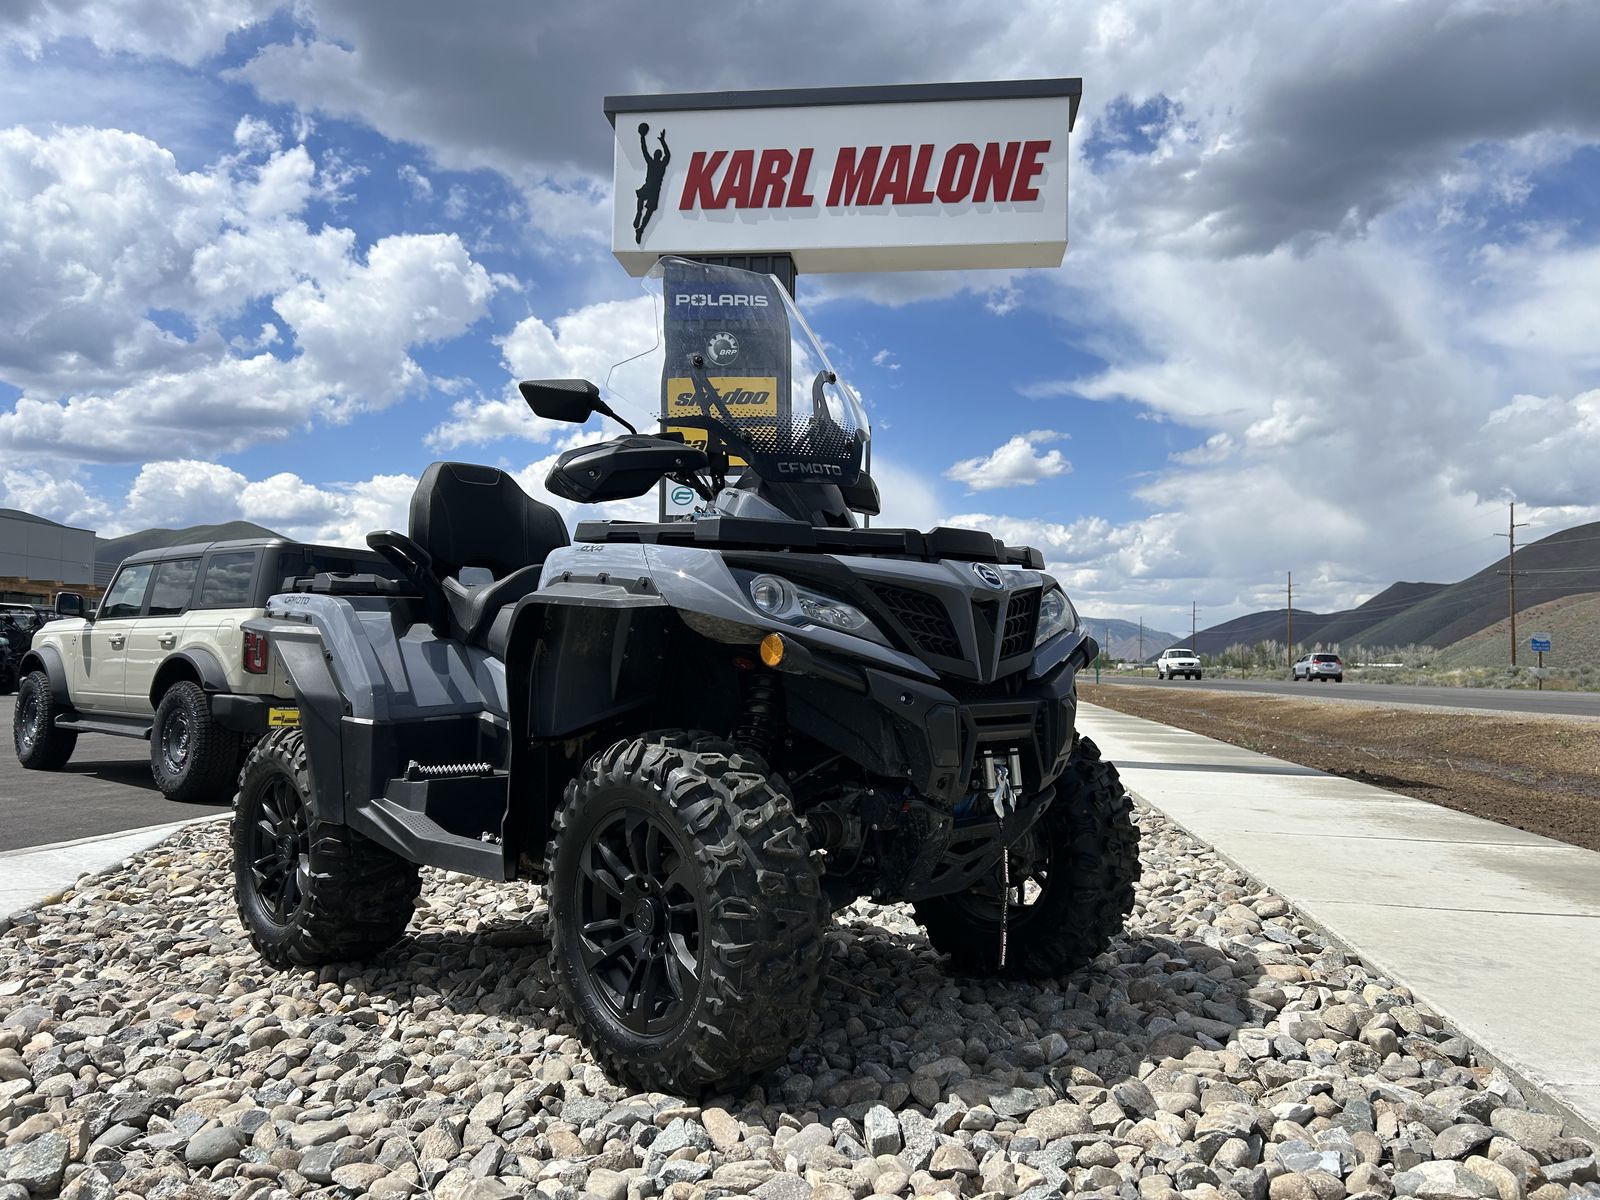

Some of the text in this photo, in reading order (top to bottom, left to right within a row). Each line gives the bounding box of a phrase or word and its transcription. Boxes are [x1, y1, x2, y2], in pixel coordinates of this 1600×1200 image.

[679, 140, 1051, 210] KARL MALONE
[675, 294, 769, 307] POLARIS
[675, 388, 770, 406] sdoo
[777, 462, 842, 476] CFMOTO
